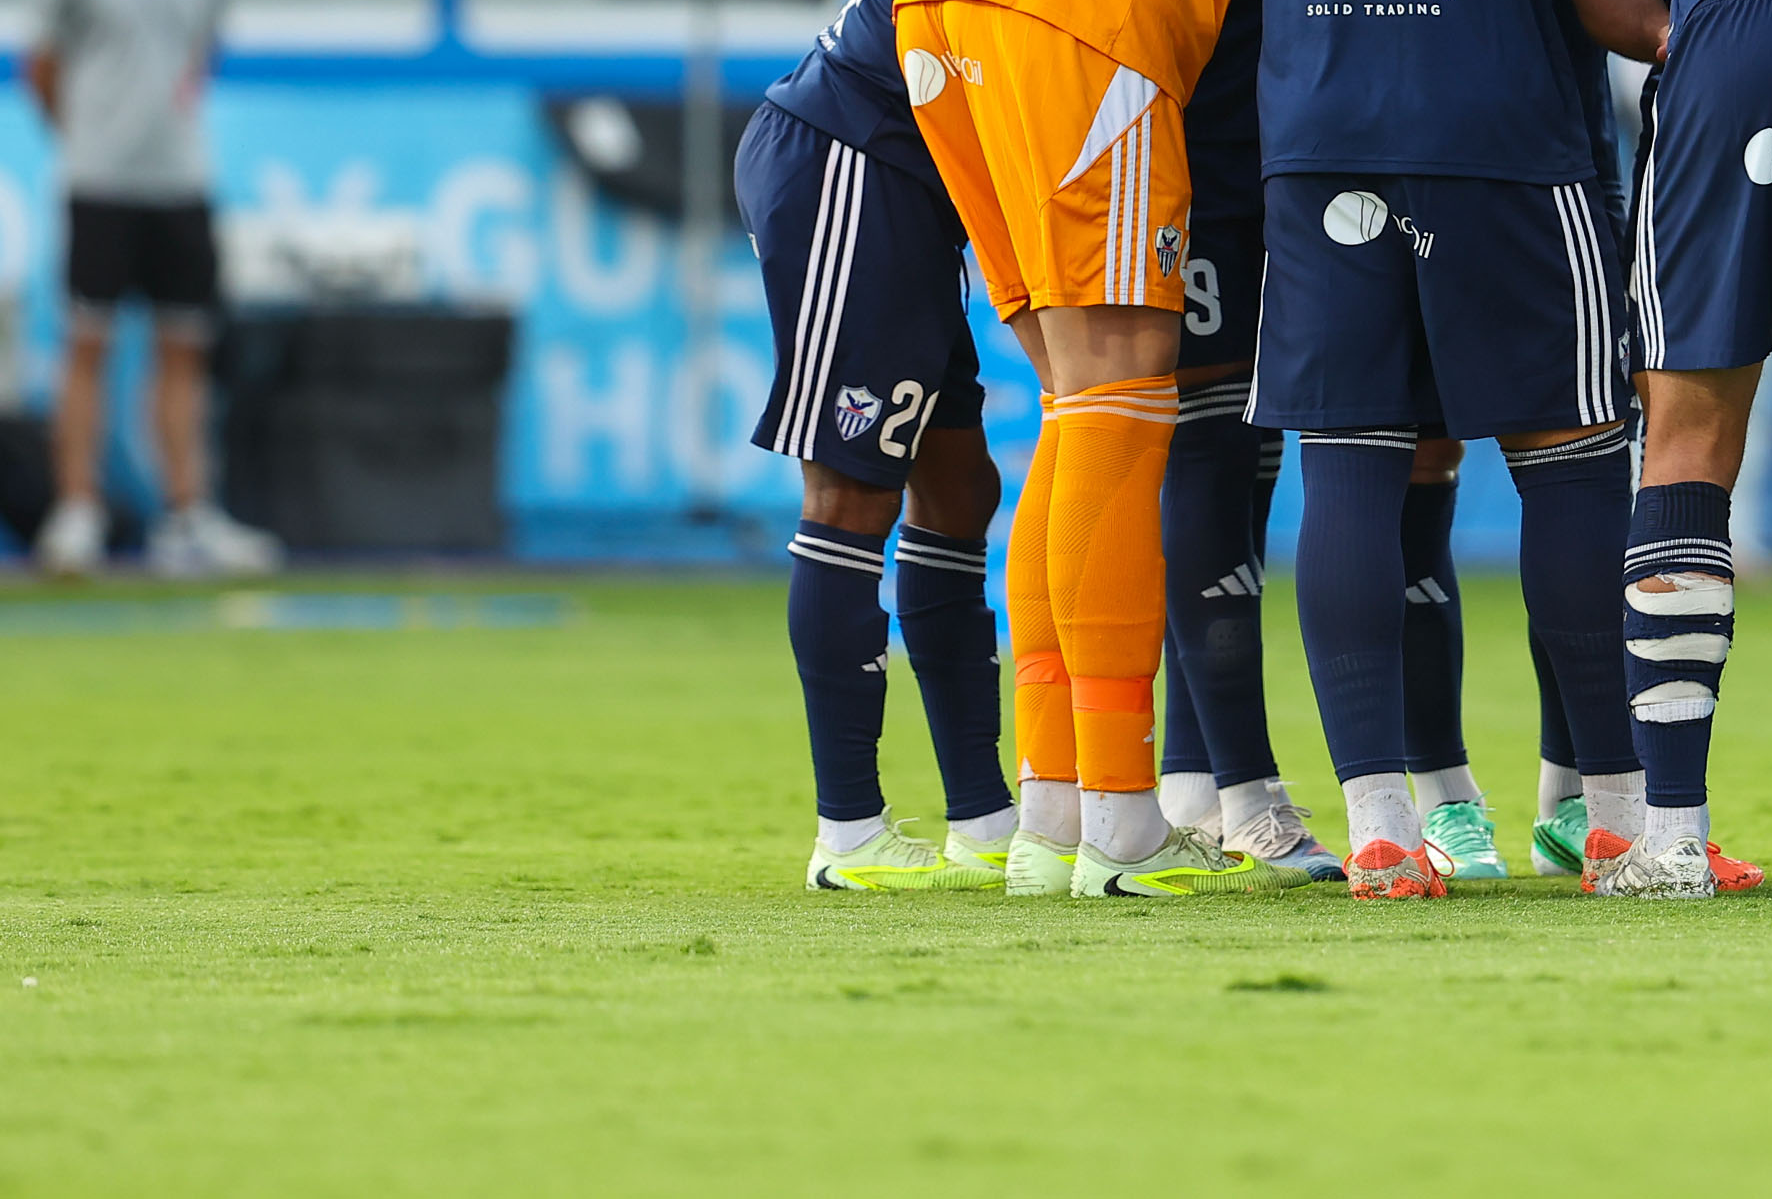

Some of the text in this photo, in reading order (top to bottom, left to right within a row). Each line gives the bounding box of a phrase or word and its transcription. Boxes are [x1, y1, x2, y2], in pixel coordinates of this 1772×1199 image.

[1306, 4, 1442, 16] SOLID TRADING
[960, 56, 984, 87] Oil
